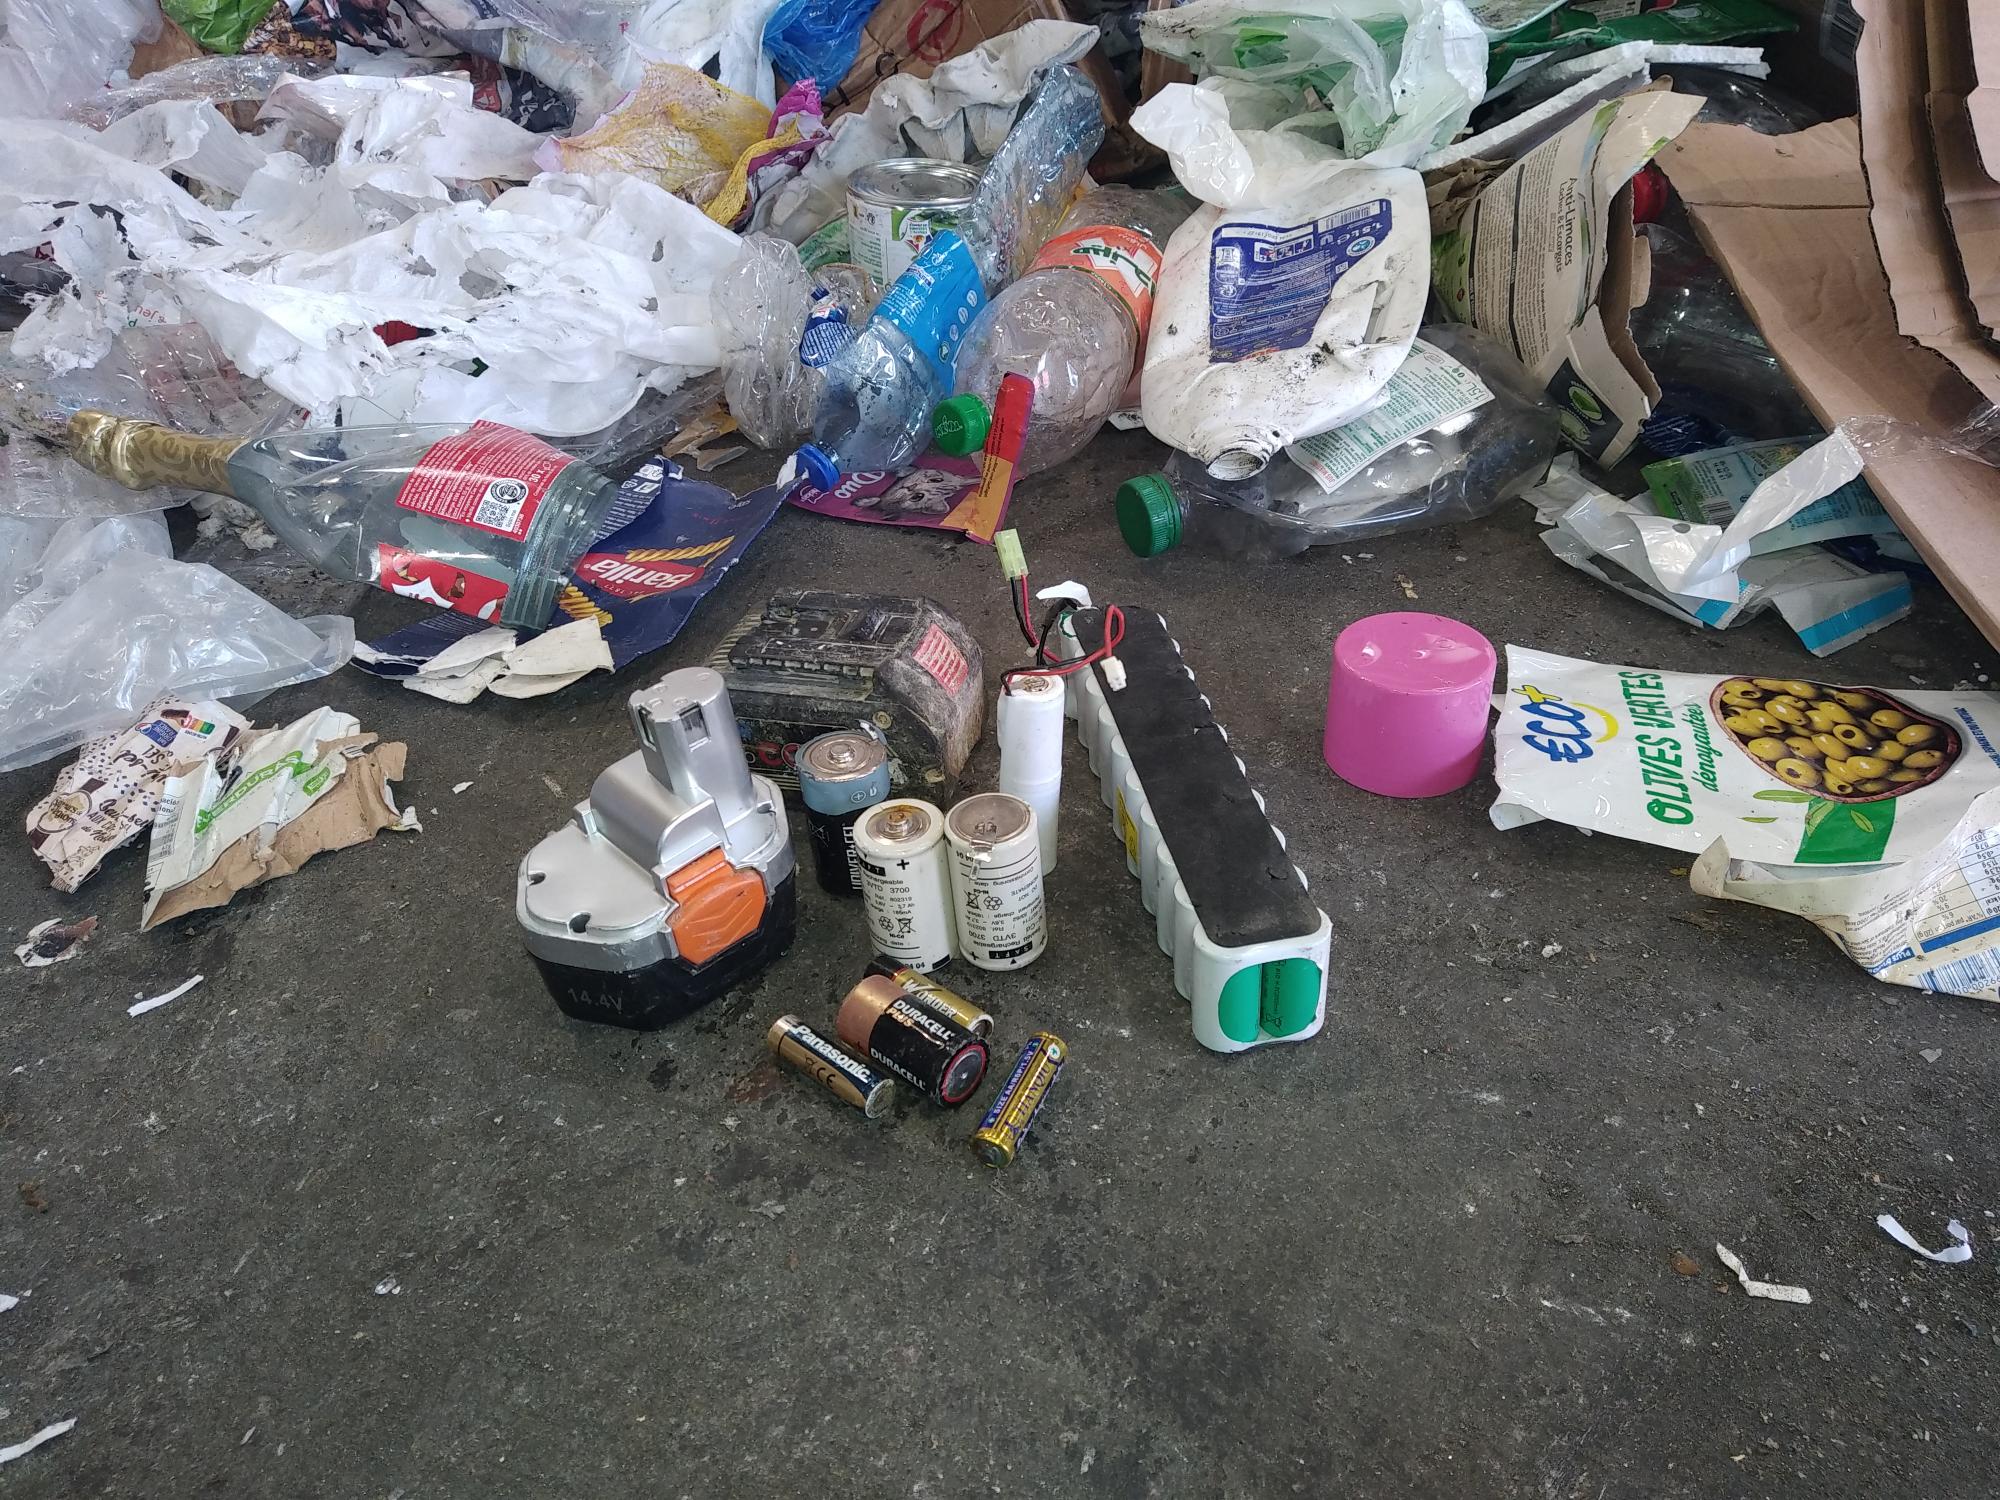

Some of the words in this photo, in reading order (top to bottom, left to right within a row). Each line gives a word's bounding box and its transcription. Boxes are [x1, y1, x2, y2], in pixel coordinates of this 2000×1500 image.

[1564, 177, 1578, 267] Anti-Limaces
[834, 470, 886, 501] Duo
[590, 559, 696, 589] Barilla
[1617, 671, 1677, 730] VERTES
[1681, 702, 1724, 793] dénoyautées
[1634, 734, 1695, 826] OLIVES
[889, 886, 911, 894] 3700
[992, 931, 1018, 942] 3VTD
[994, 944, 1031, 960] SAFT
[567, 986, 622, 1015] 14.4V
[902, 978, 959, 1018] WONDER
[886, 1007, 915, 1028] PLUS
[892, 999, 954, 1041] DURACELL
[789, 1024, 872, 1085] Panasonic
[870, 1047, 927, 1091] DURACELL
[993, 1096, 1009, 1115] SIZE
